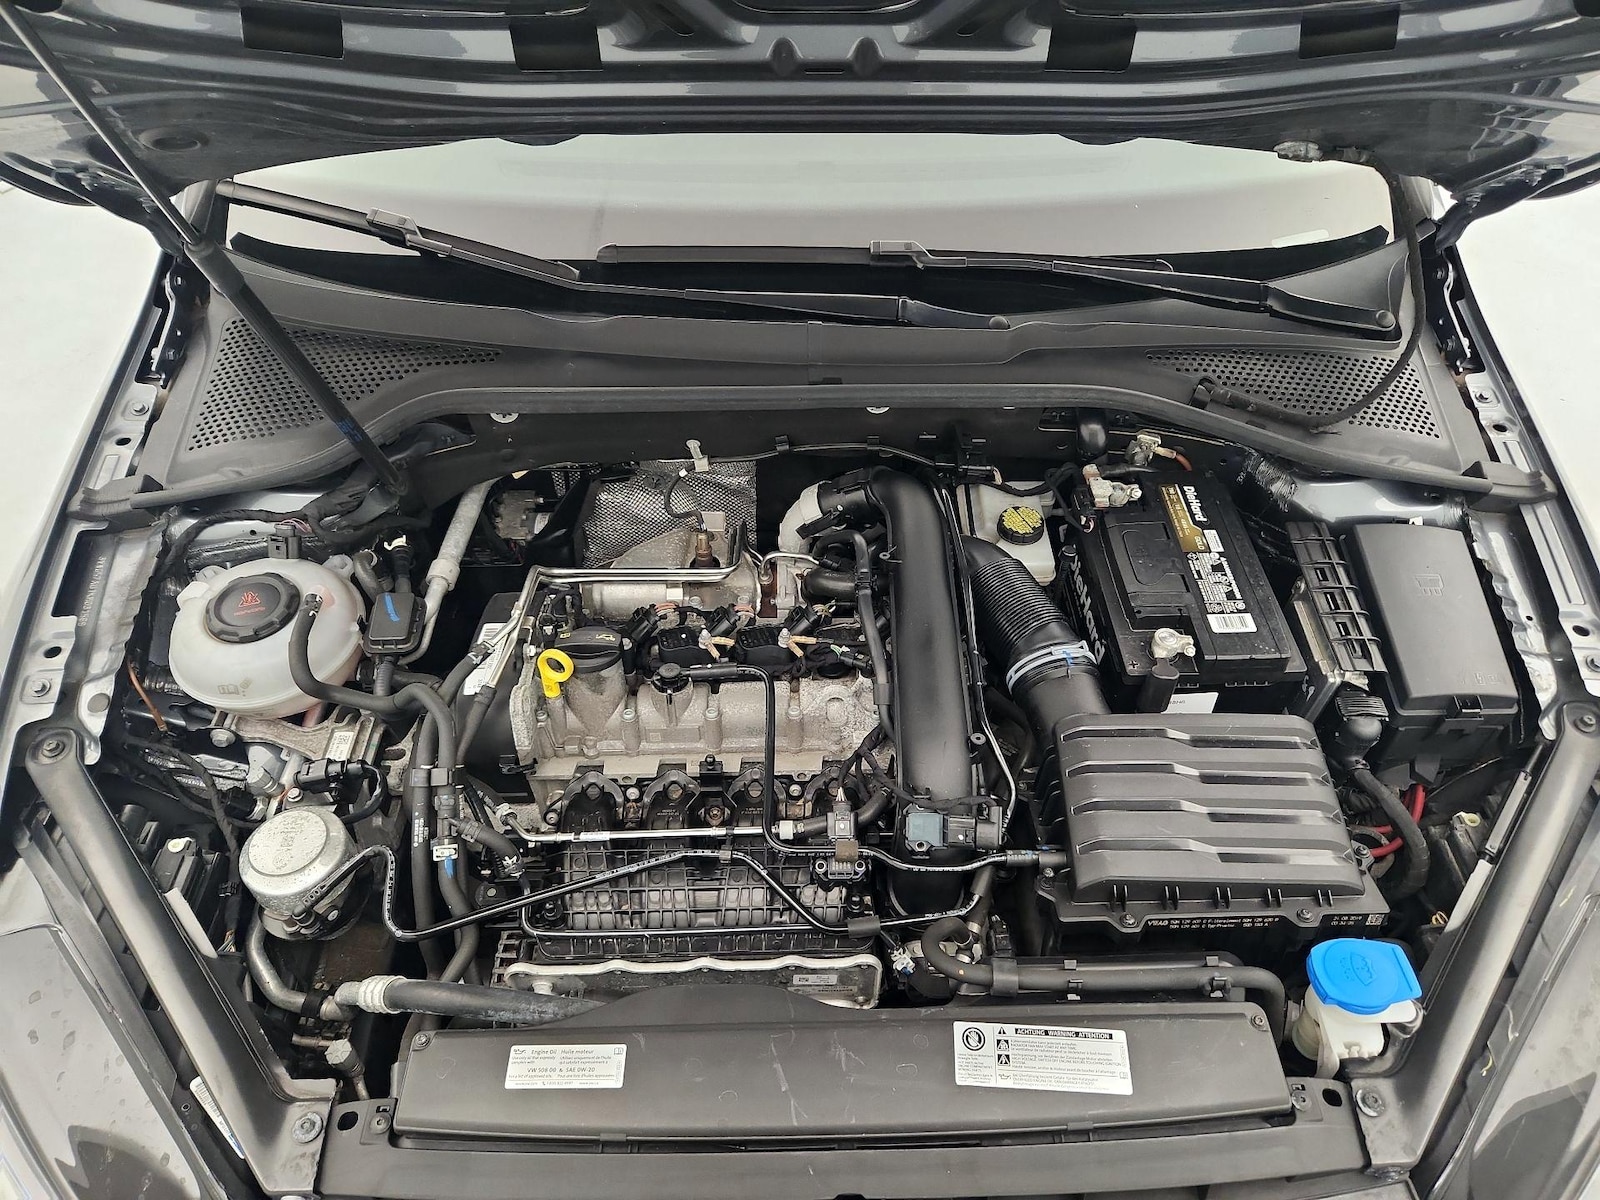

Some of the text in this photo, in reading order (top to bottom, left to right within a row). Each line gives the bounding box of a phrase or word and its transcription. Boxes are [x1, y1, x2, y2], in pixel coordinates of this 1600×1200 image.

[1182, 485, 1208, 523] DieHard
[1193, 535, 1205, 550] GOLD
[1048, 1030, 1076, 1038] WARNING
[1078, 1031, 1110, 1040] ATTENTION
